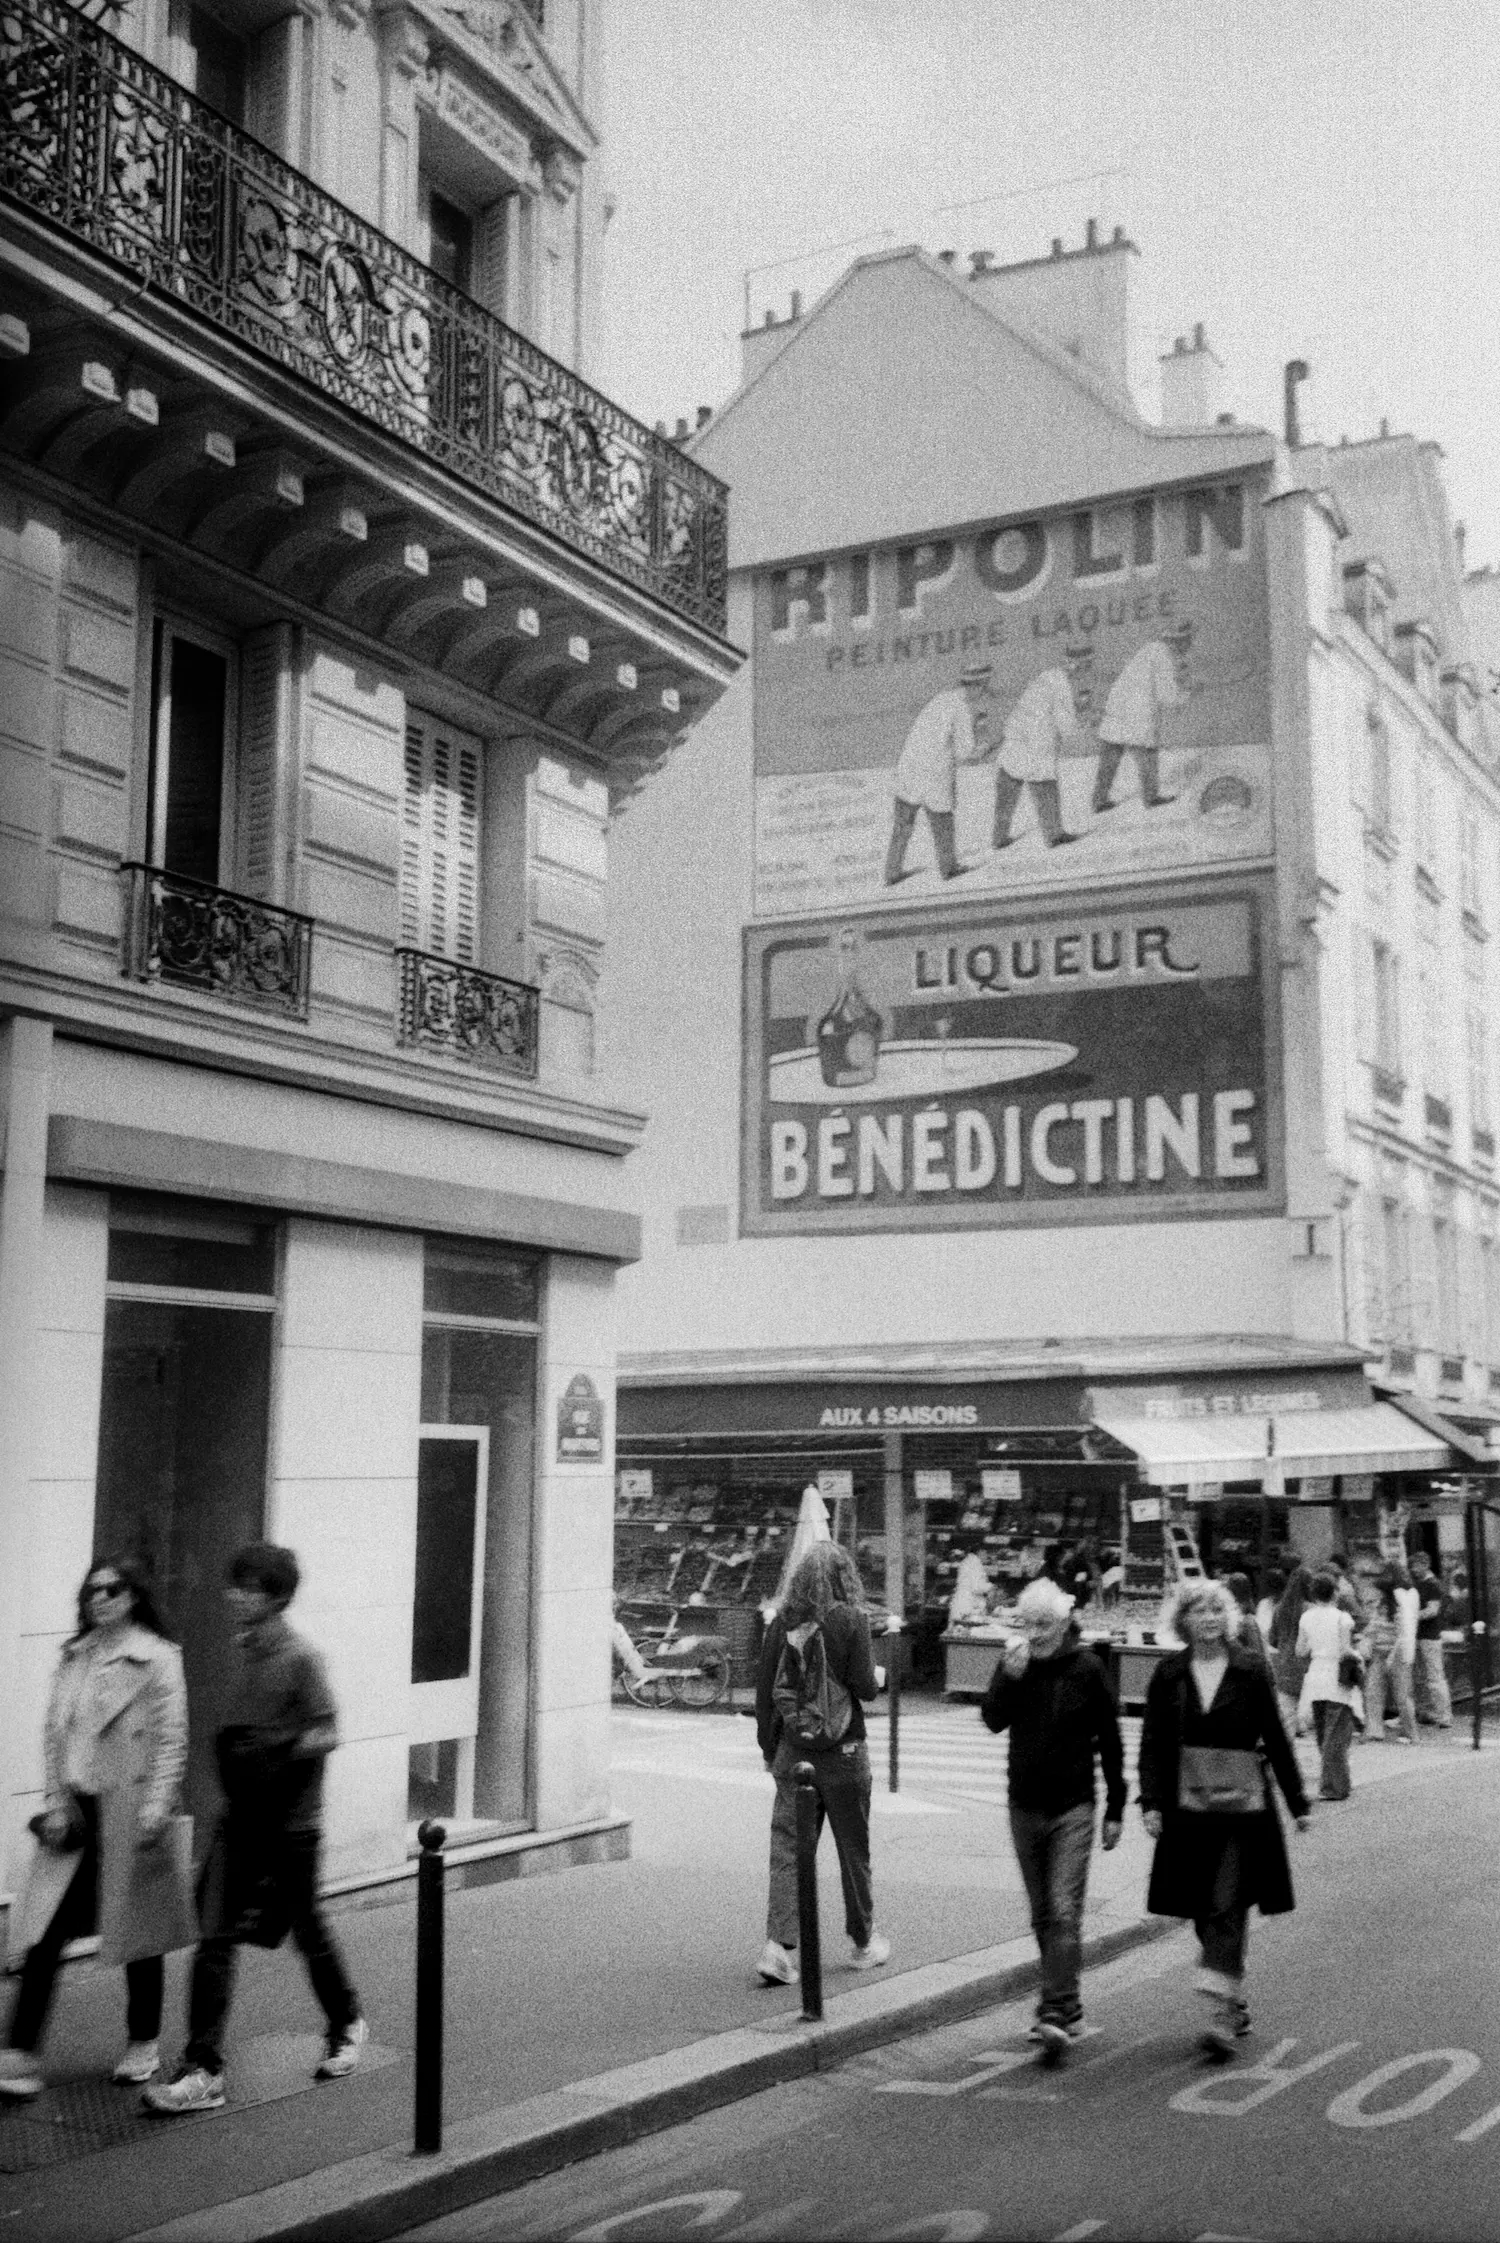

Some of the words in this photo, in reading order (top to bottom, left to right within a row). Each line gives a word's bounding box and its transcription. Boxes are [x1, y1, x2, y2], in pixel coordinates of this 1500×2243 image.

[768, 485, 1252, 641] RIPOLIN
[825, 623, 1006, 671] PEINTURE
[915, 925, 1201, 992] LIQUEUR
[771, 1090, 1261, 1199] BÉNÉDICTINE
[821, 1407, 863, 1427] AUX
[867, 1408, 881, 1426] 4
[884, 1405, 979, 1426] SAISONS
